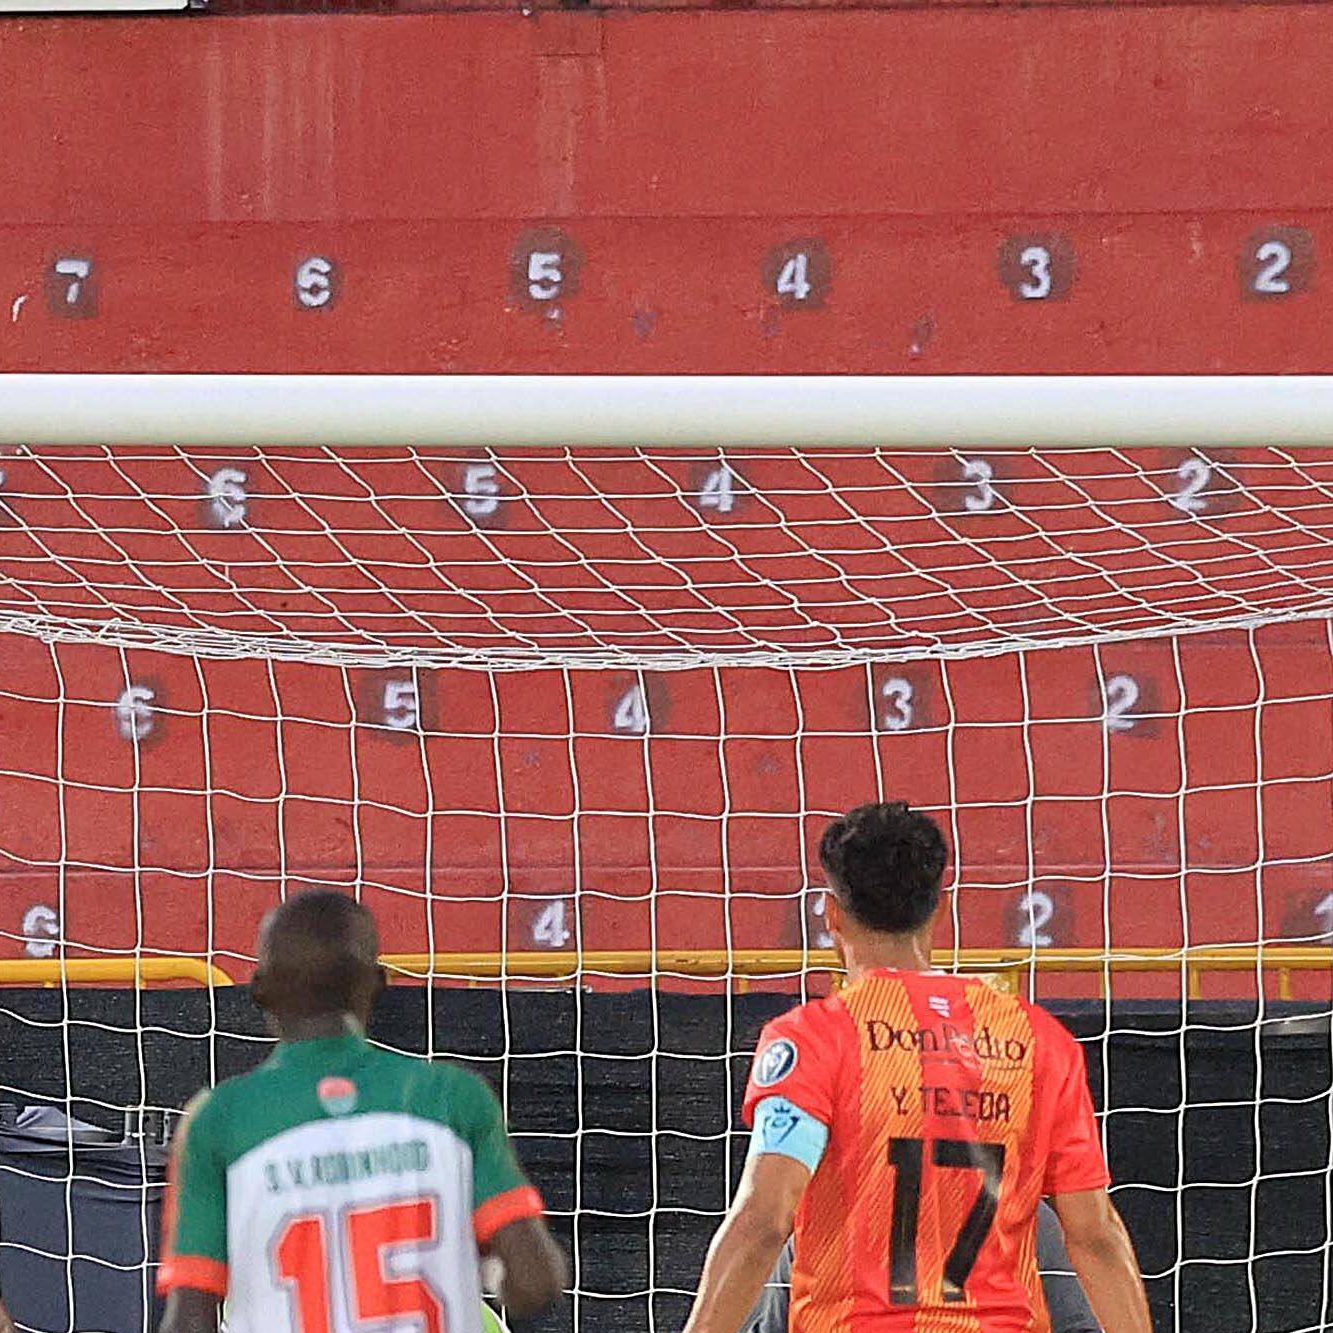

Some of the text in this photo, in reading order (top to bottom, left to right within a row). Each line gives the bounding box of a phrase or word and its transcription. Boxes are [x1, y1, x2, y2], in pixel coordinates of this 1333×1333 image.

[55, 258, 90, 303] 7
[296, 257, 331, 307] 6
[528, 253, 562, 299] 5
[777, 253, 811, 299] 4
[1020, 247, 1052, 299] 3
[1254, 241, 1291, 292] 2
[210, 468, 247, 526] 6
[465, 464, 499, 513] 5
[700, 464, 734, 512] 4
[962, 459, 994, 511] 3
[1174, 458, 1211, 512] 2
[117, 685, 155, 741] 6
[383, 681, 418, 730] 5
[613, 682, 649, 733] 4
[882, 678, 914, 731] 3
[1106, 674, 1140, 731] 2
[23, 906, 60, 957] 6
[534, 901, 570, 947] 4
[1019, 891, 1054, 946] 2
[887, 1137, 1005, 1305] 17
